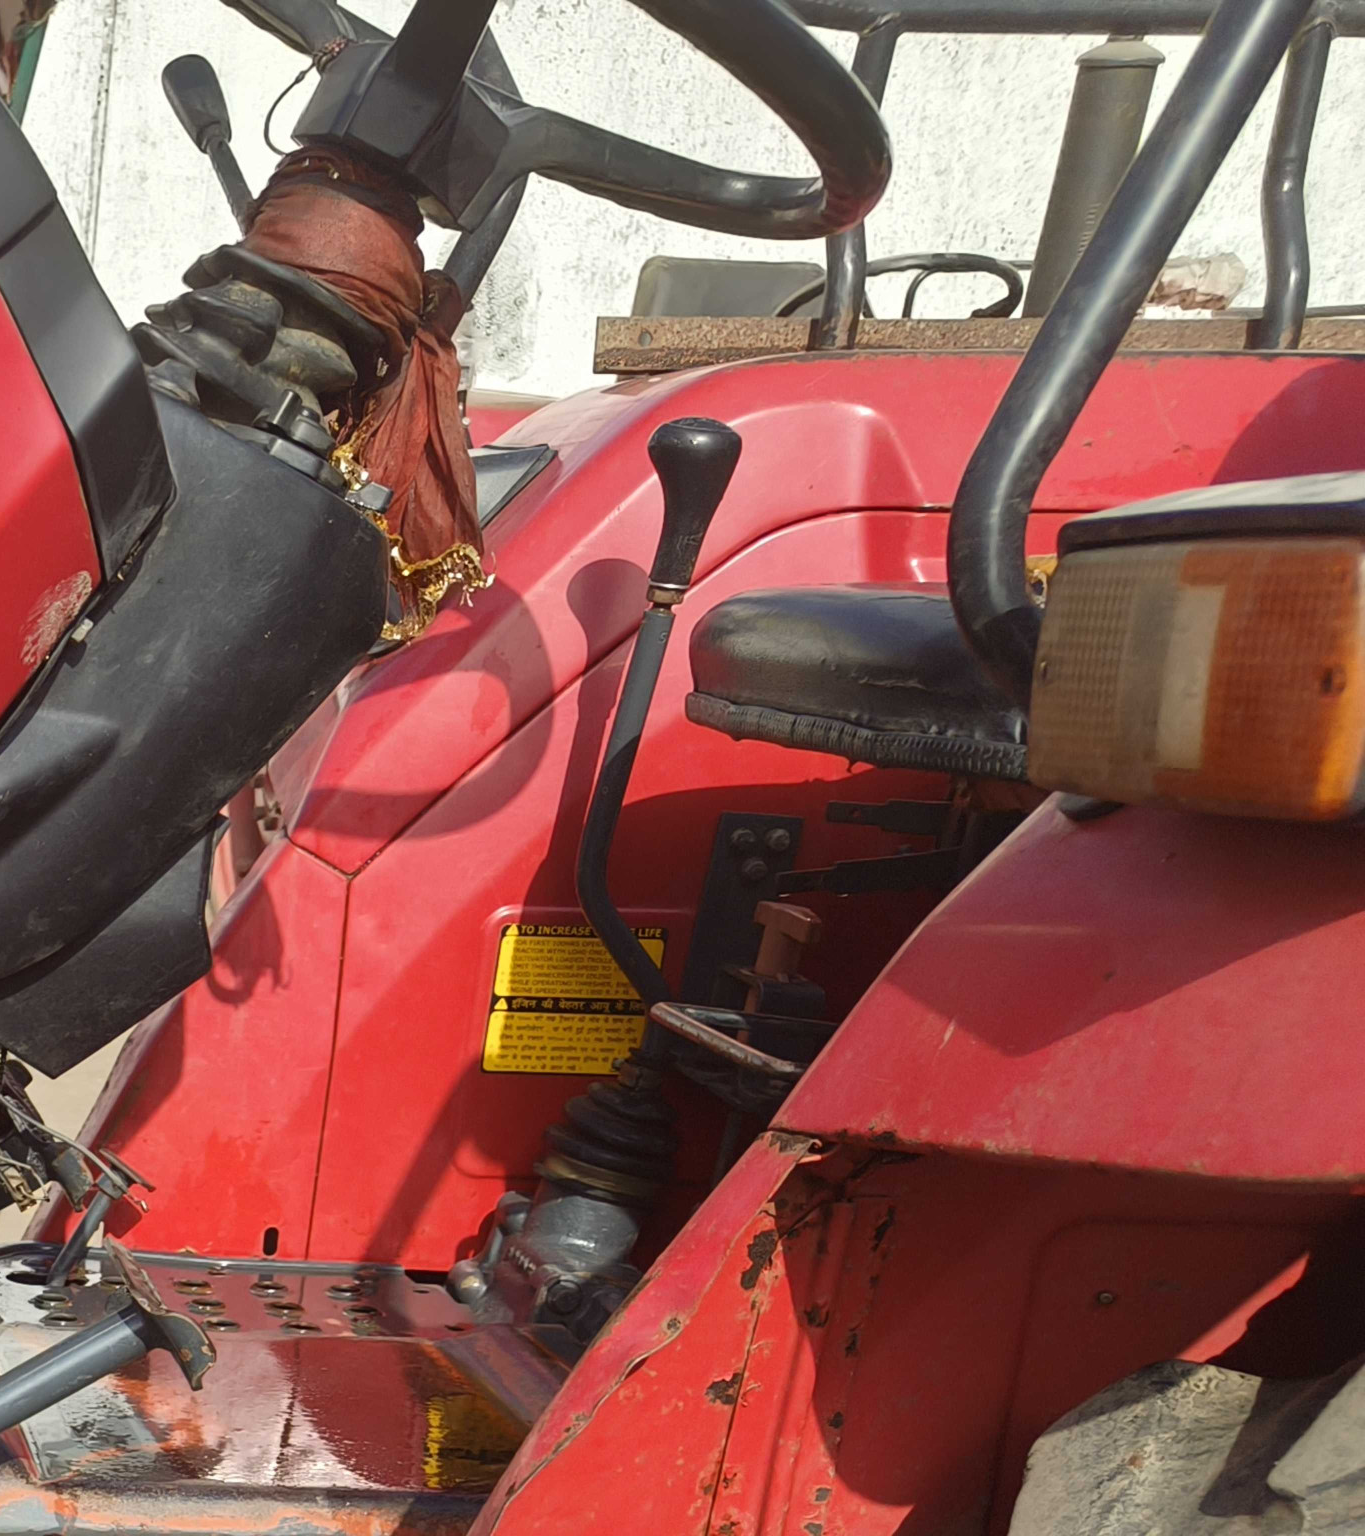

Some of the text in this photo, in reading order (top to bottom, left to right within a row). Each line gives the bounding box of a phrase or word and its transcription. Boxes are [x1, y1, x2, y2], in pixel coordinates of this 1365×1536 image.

[521, 925, 535, 934] TO
[536, 925, 591, 936] INCREASE
[637, 928, 663, 937] LIFE
